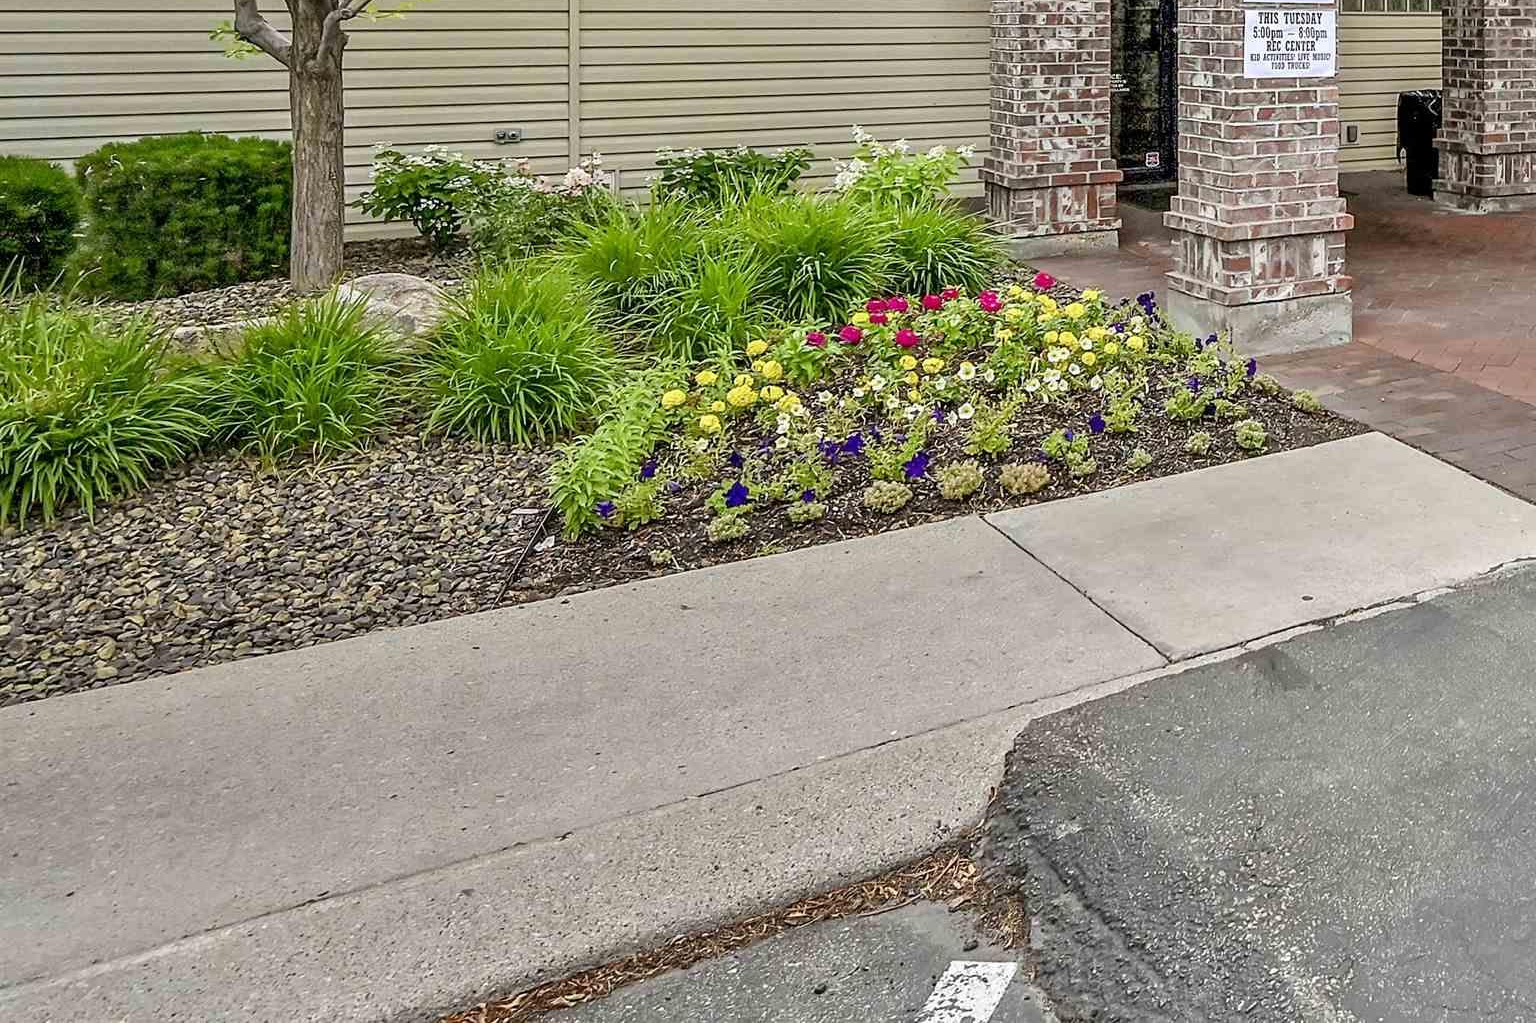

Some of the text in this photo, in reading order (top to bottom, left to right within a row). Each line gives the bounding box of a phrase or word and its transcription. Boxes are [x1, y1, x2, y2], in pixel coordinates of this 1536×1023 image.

[1258, 12, 1323, 25] THIS TUESDAY
[1252, 26, 1284, 41] 5:00pm
[1298, 26, 1328, 41] 8:00pm
[1266, 41, 1316, 52] REC CENTER
